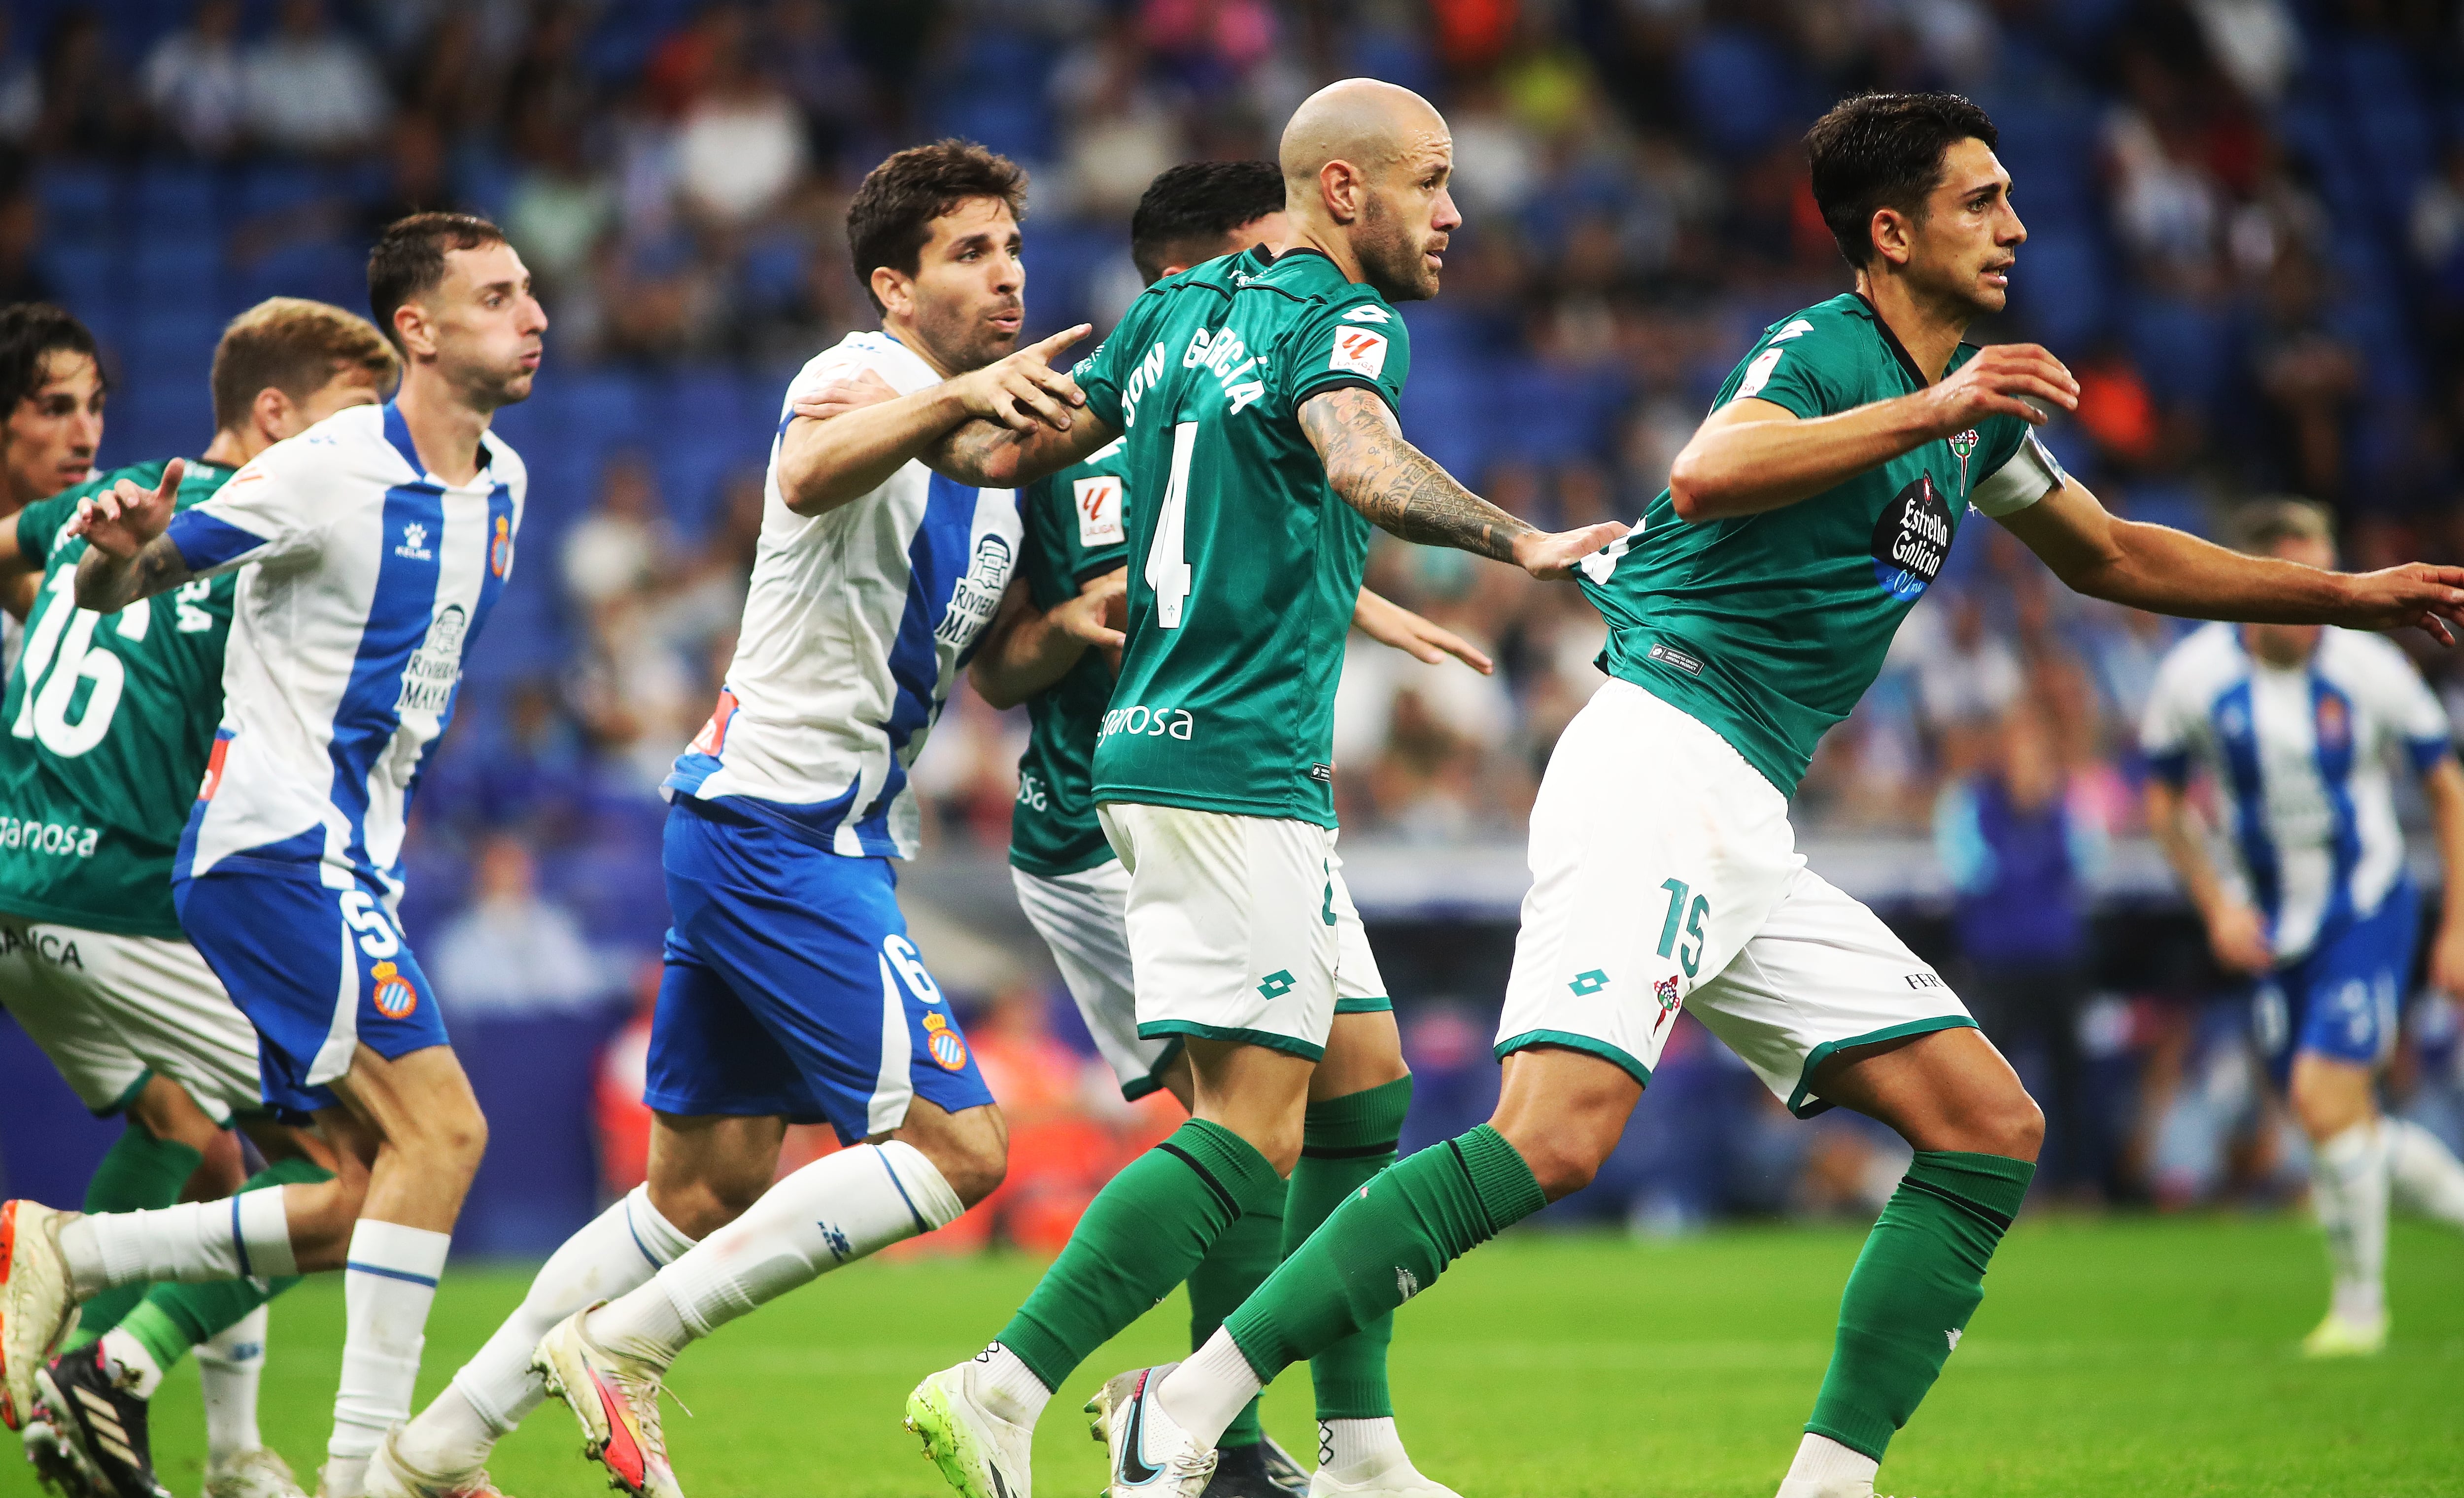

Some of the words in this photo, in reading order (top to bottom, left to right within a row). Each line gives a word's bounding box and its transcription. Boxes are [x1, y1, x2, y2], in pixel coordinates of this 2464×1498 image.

[1122, 341, 1165, 427] JON
[1145, 421, 1198, 628] 4
[1893, 530, 1940, 577] Galicia
[1900, 497, 1948, 547] Estrella
[11, 563, 150, 758] 16
[339, 891, 399, 958] 5
[1655, 877, 1710, 978] 15
[884, 934, 941, 1004] 6
[1903, 974, 1944, 989] FER
